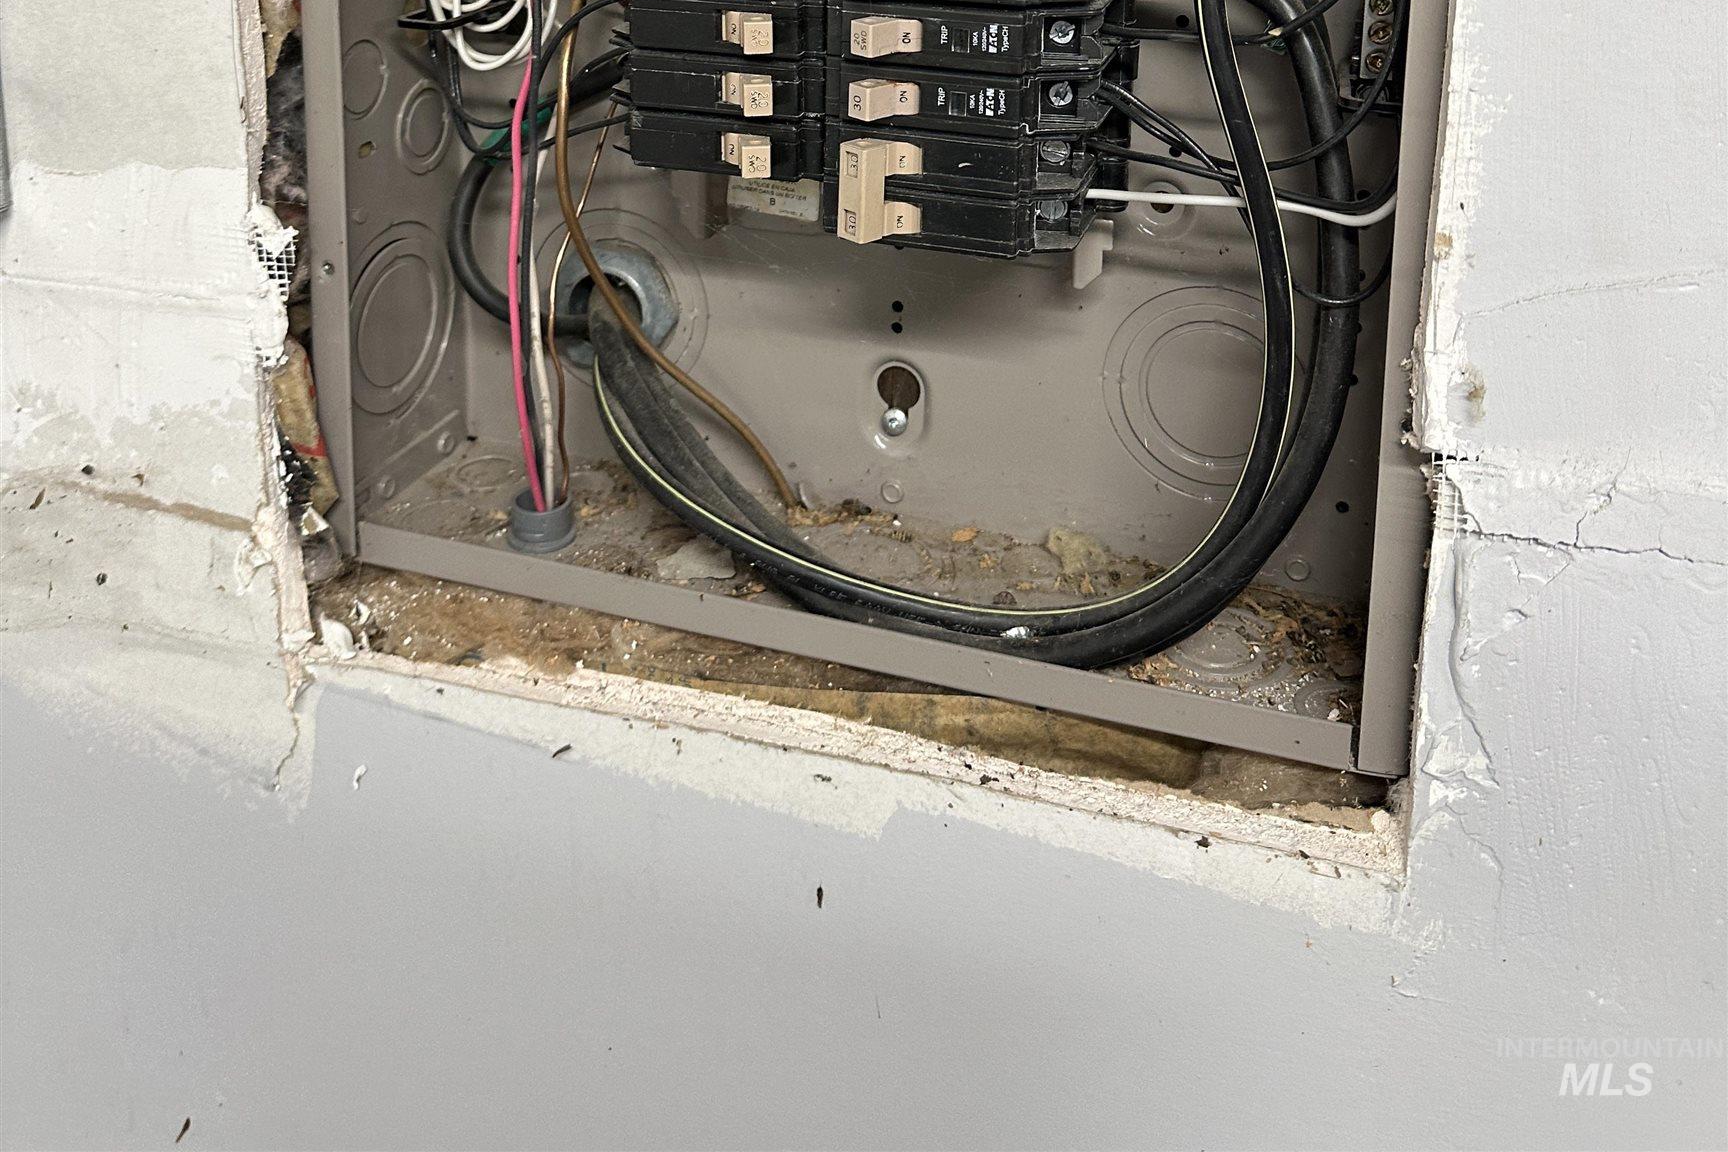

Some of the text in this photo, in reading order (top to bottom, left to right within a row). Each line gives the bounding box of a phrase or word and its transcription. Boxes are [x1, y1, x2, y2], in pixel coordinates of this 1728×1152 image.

[853, 32, 860, 46] 20
[902, 32, 911, 45] ON
[940, 25, 948, 45] TRIP
[853, 95, 861, 111] 30
[899, 90, 908, 103] ON
[937, 87, 945, 107] TRIP
[756, 156, 767, 172] 20
[850, 154, 859, 171] 30
[900, 155, 906, 169] ON
[848, 215, 857, 230] 30
[897, 215, 904, 229] ON
